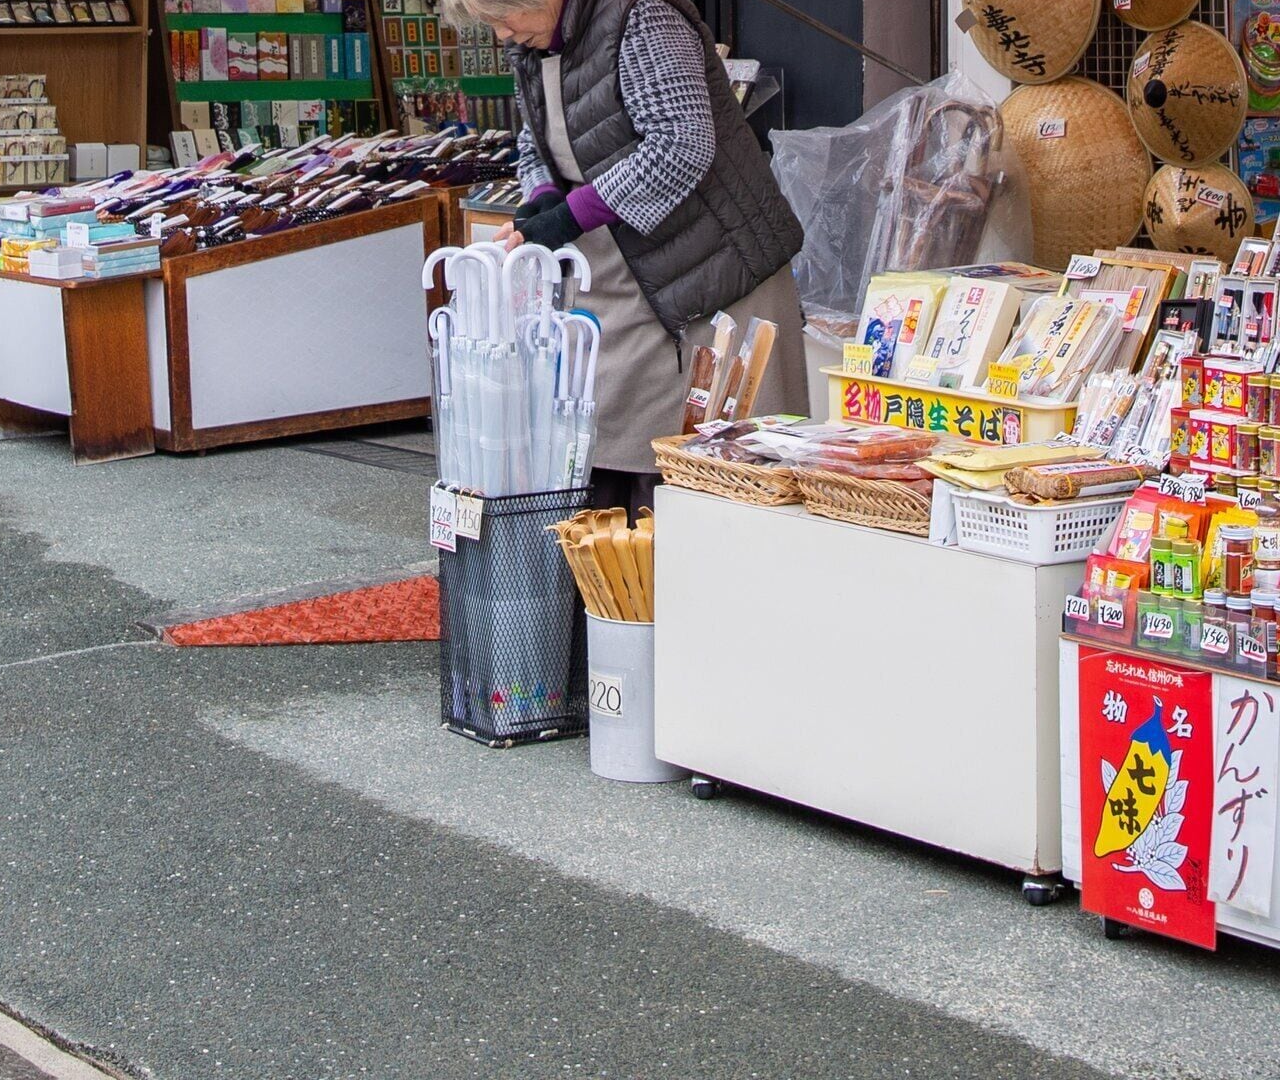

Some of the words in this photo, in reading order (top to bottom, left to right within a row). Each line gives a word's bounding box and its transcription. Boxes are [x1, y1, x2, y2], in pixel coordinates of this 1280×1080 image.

[982, 5, 1047, 77] 善光寺
[1070, 258, 1098, 274] ¥1080
[844, 356, 872, 375] ¥540
[989, 377, 1018, 397] ¥870
[844, 380, 1001, 442] 名物戸隠生そば
[456, 505, 481, 532] ¥450
[1100, 604, 1123, 622] ¥300
[1108, 753, 1157, 836] 七味
[1217, 688, 1275, 902] かんずり
